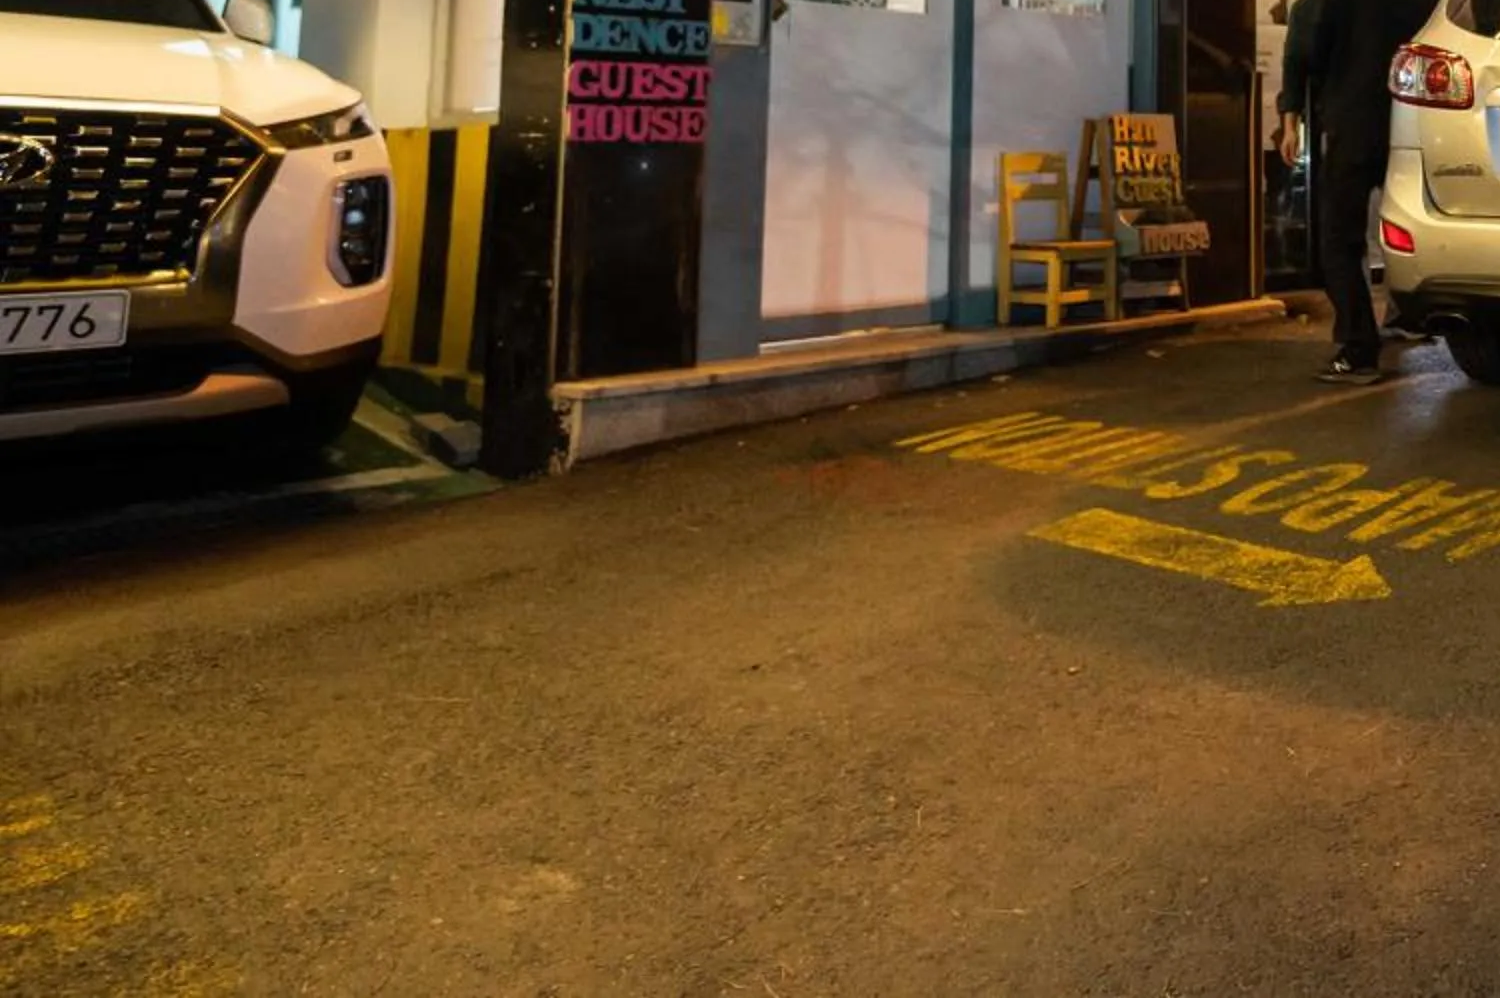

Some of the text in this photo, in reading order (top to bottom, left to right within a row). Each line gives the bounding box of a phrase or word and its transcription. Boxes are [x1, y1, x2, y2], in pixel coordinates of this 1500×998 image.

[573, 13, 711, 57] DENCE
[570, 60, 714, 101] GUEST
[567, 103, 707, 143] HOUSE
